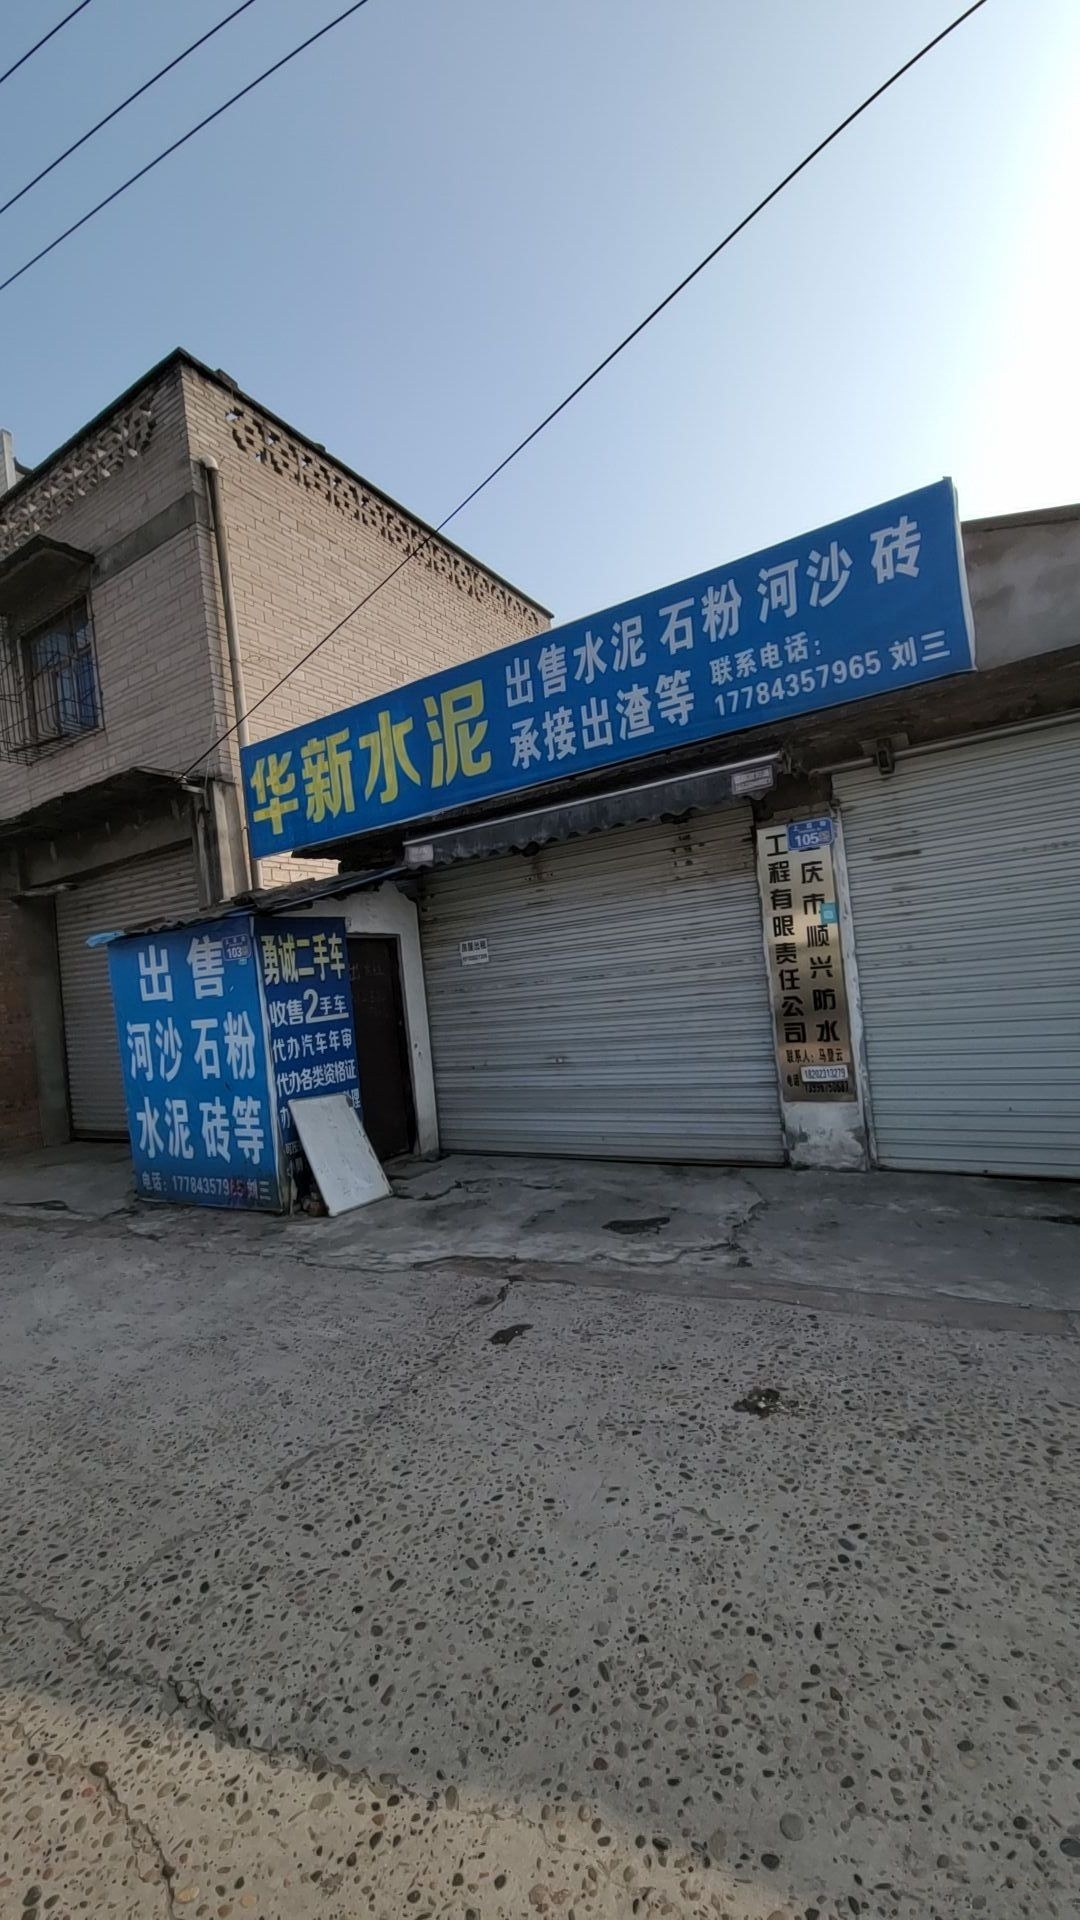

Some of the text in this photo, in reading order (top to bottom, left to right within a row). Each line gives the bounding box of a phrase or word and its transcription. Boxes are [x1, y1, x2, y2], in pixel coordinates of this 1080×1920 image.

[504, 515, 922, 708] 出售水泥 石粉 河沙 砖
[714, 630, 951, 716] 17784357965 刘三
[510, 669, 695, 770] 承接出渣等
[250, 678, 491, 835] 华新水泥
[794, 832, 820, 847] 105
[137, 934, 225, 1002] 出售
[227, 946, 242, 959] 103
[260, 932, 346, 986] 勇诚二手车
[765, 833, 807, 1044] 工程有限责任公司
[799, 846, 841, 1043] 庆市顺兴防水
[126, 1010, 256, 1083] 河沙 石粉
[273, 1028, 353, 1064] 代办汽车年审
[277, 1058, 357, 1098] 代办各类资格证
[136, 1094, 265, 1166] 水泥 砖等
